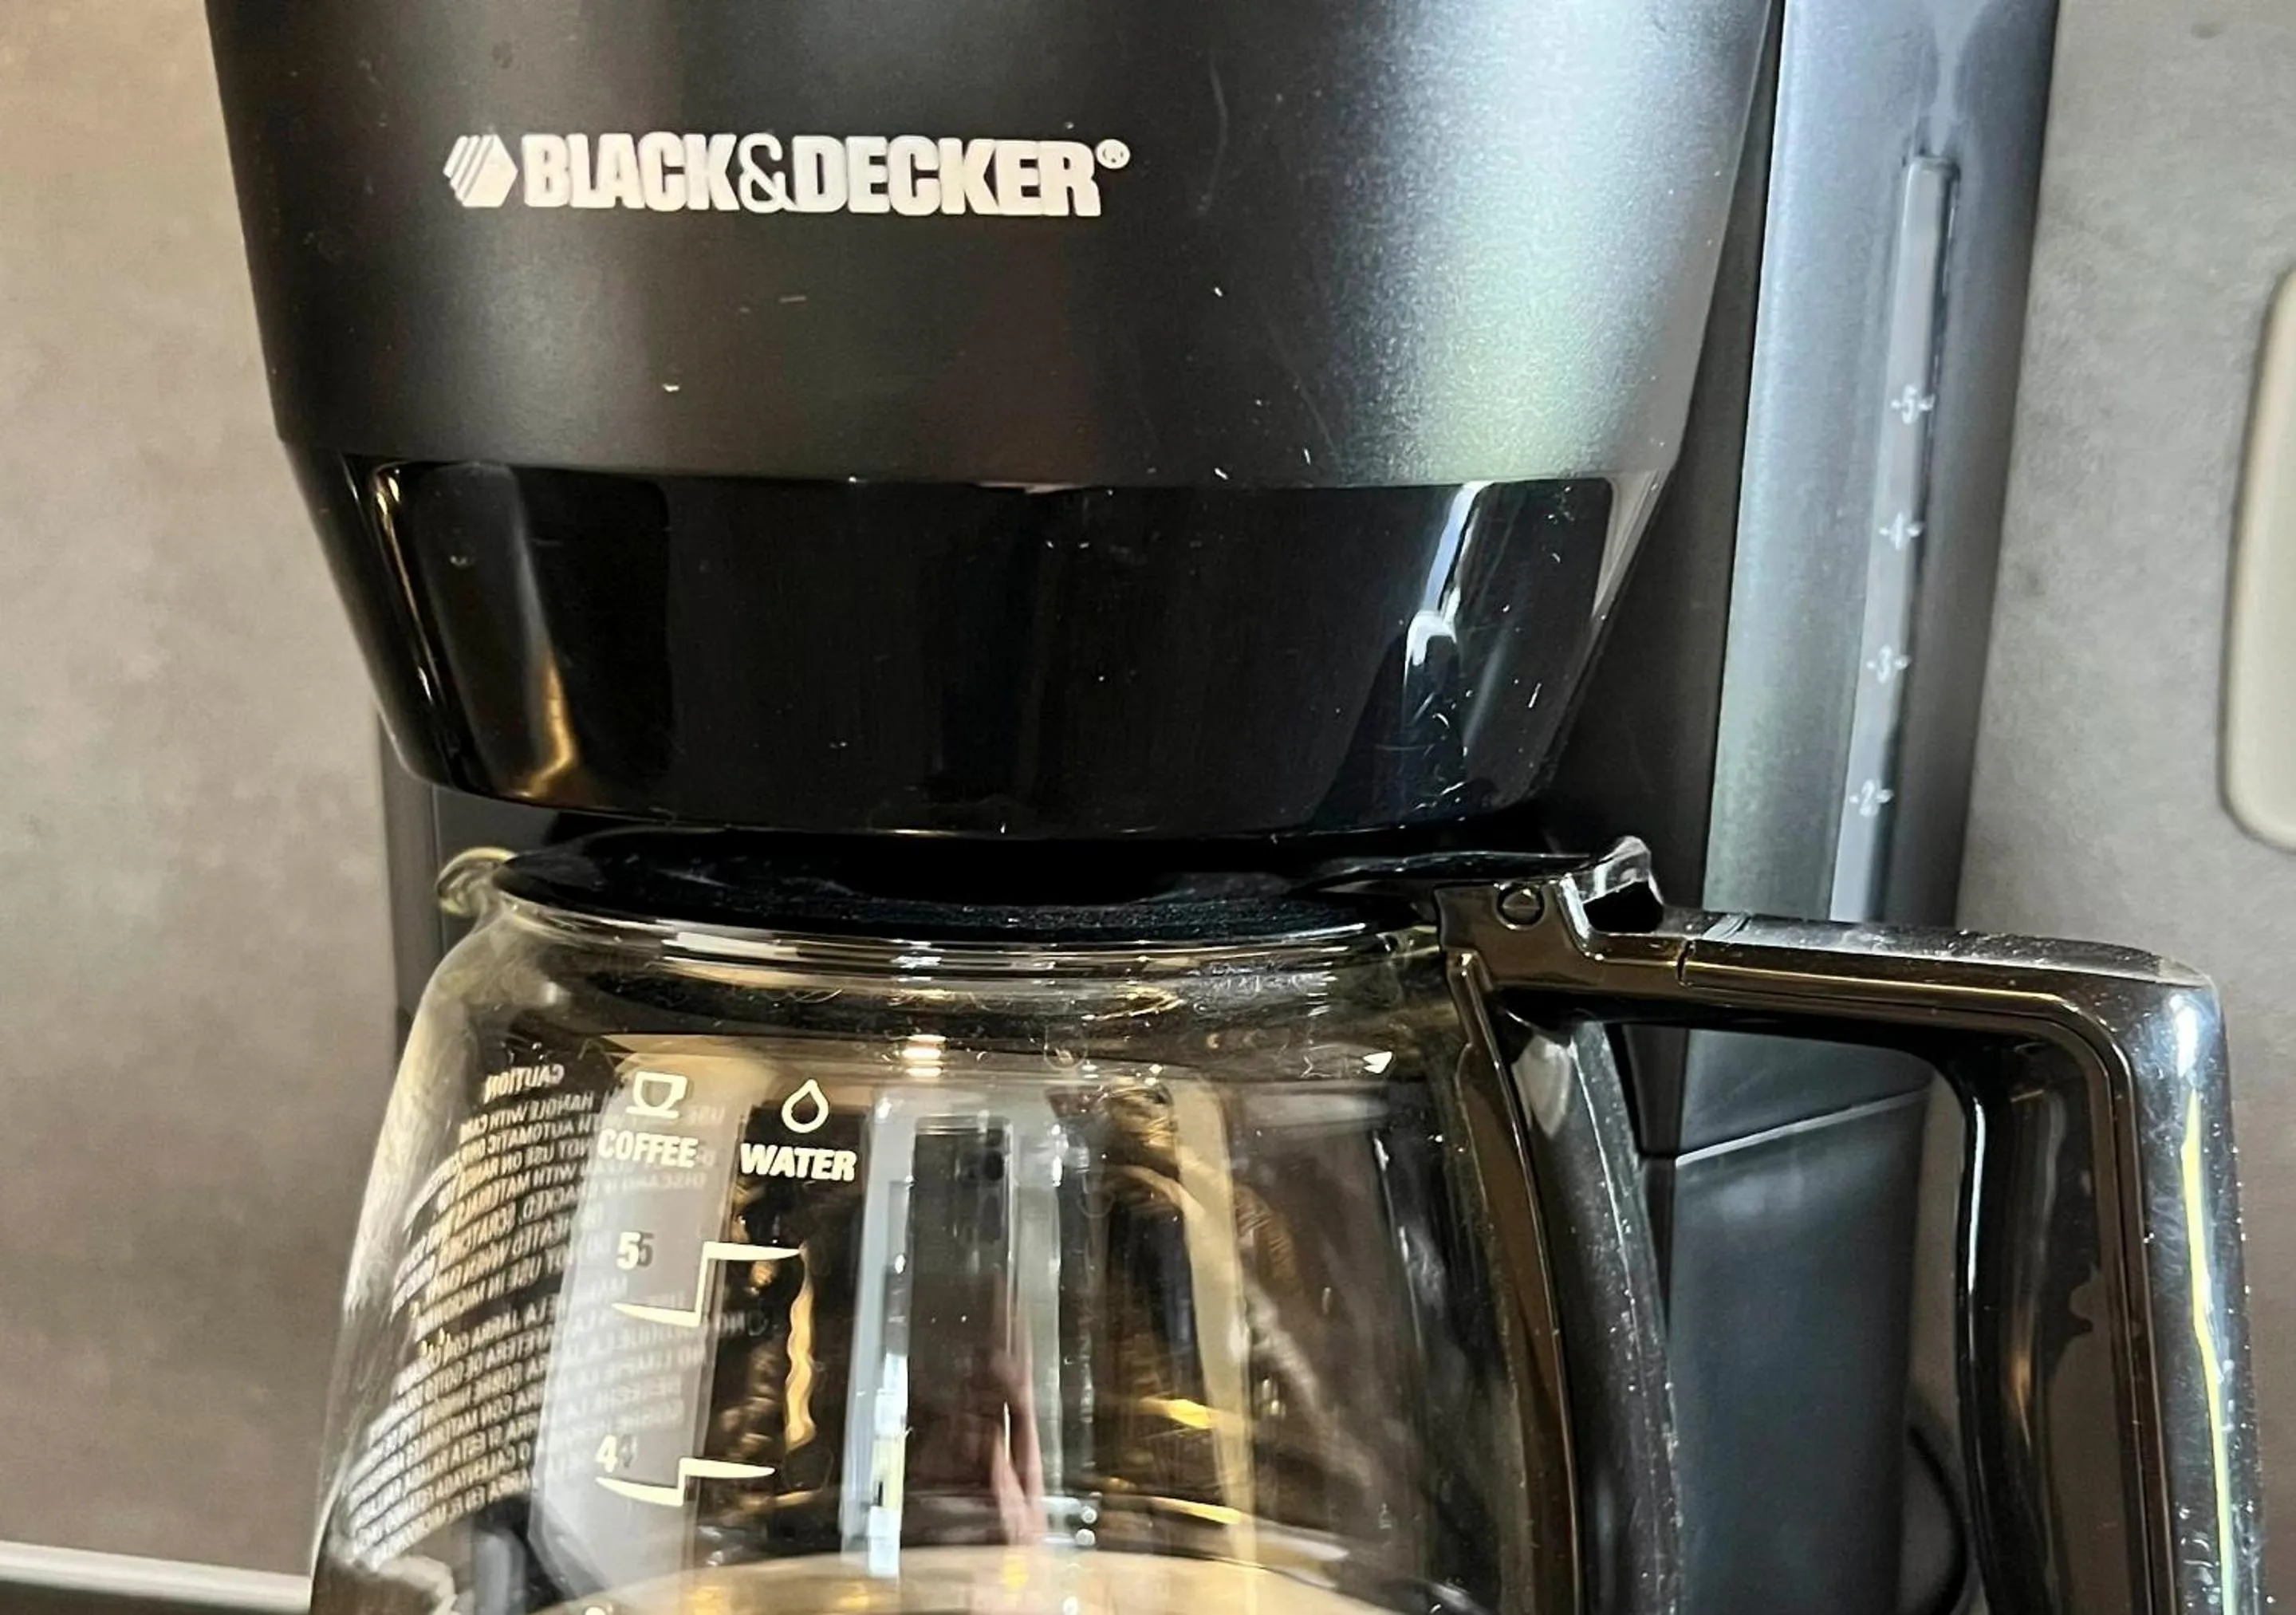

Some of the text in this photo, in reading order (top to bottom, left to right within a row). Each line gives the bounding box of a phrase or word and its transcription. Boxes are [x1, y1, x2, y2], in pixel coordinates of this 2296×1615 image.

[597, 1128, 699, 1168] COFFEE
[740, 1143, 857, 1181] WATER
[595, 1434, 617, 1473] 4
